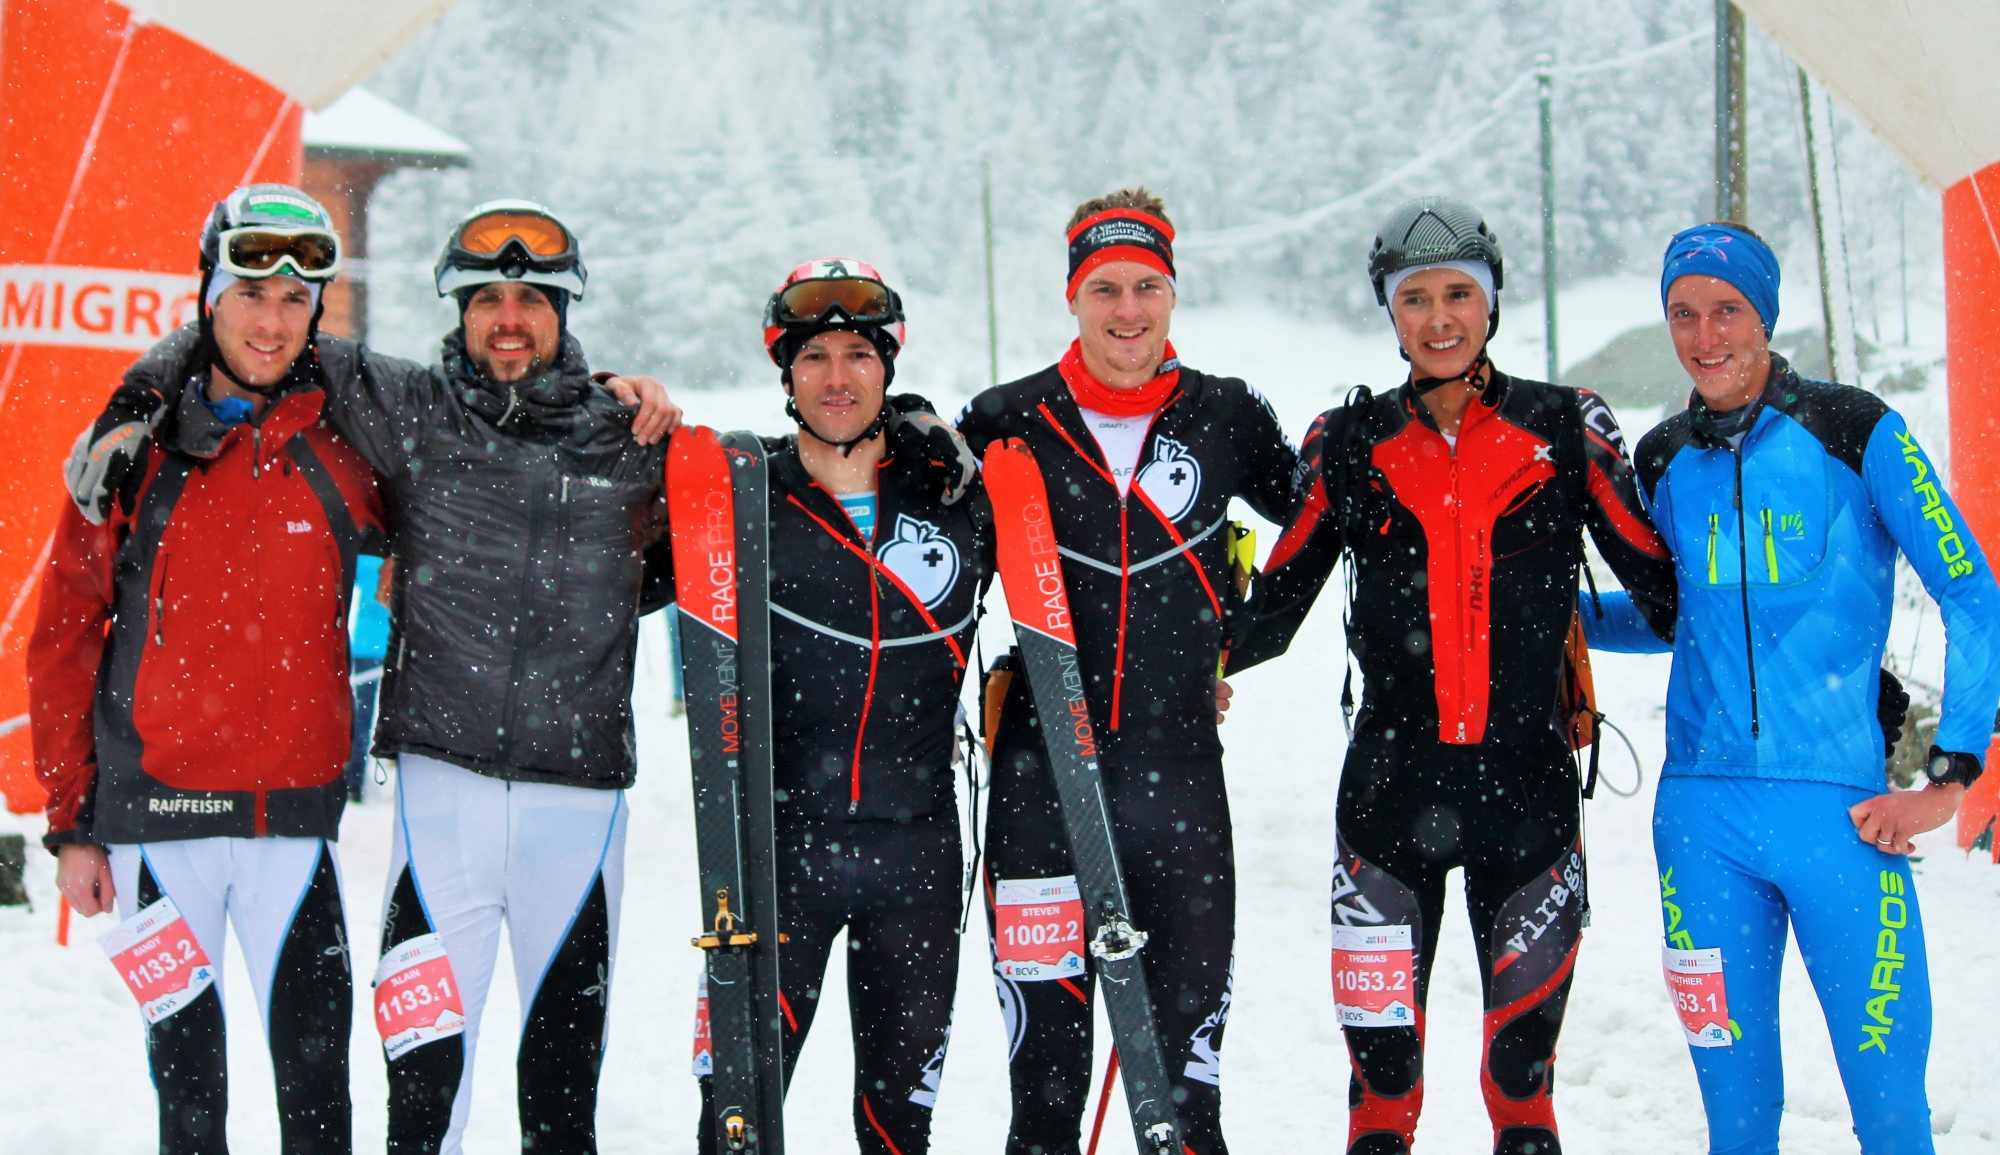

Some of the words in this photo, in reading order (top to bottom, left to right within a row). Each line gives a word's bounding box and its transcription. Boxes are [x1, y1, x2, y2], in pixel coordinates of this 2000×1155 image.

[589, 477, 612, 488] Rab
[1893, 430, 1973, 579] KARPOS
[287, 520, 312, 533] Rab
[705, 490, 730, 547] PRO
[1022, 503, 1057, 558] PRO
[710, 550, 735, 624] RACE
[1036, 559, 1070, 630] RACE
[717, 643, 740, 753] MOVEMENT
[1057, 652, 1097, 757] MOVEMENT
[149, 799, 233, 814] RAIFFEISEN
[1022, 906, 1060, 917] STEVEN
[1507, 852, 1580, 953] virage
[1004, 920, 1079, 946] 1002.2
[132, 936, 162, 957] RANDY
[1348, 954, 1387, 963] THOMAS
[129, 939, 197, 989] 1133.2
[1015, 967, 1039, 975] BCVS
[1859, 870, 1907, 1055] KARPOS
[391, 969, 420, 987] ALAIN
[1336, 970, 1407, 991] 1053.2
[155, 999, 176, 1014] BCVS
[379, 977, 452, 1022] 1133.1
[1345, 1011, 1363, 1021] BCVS
